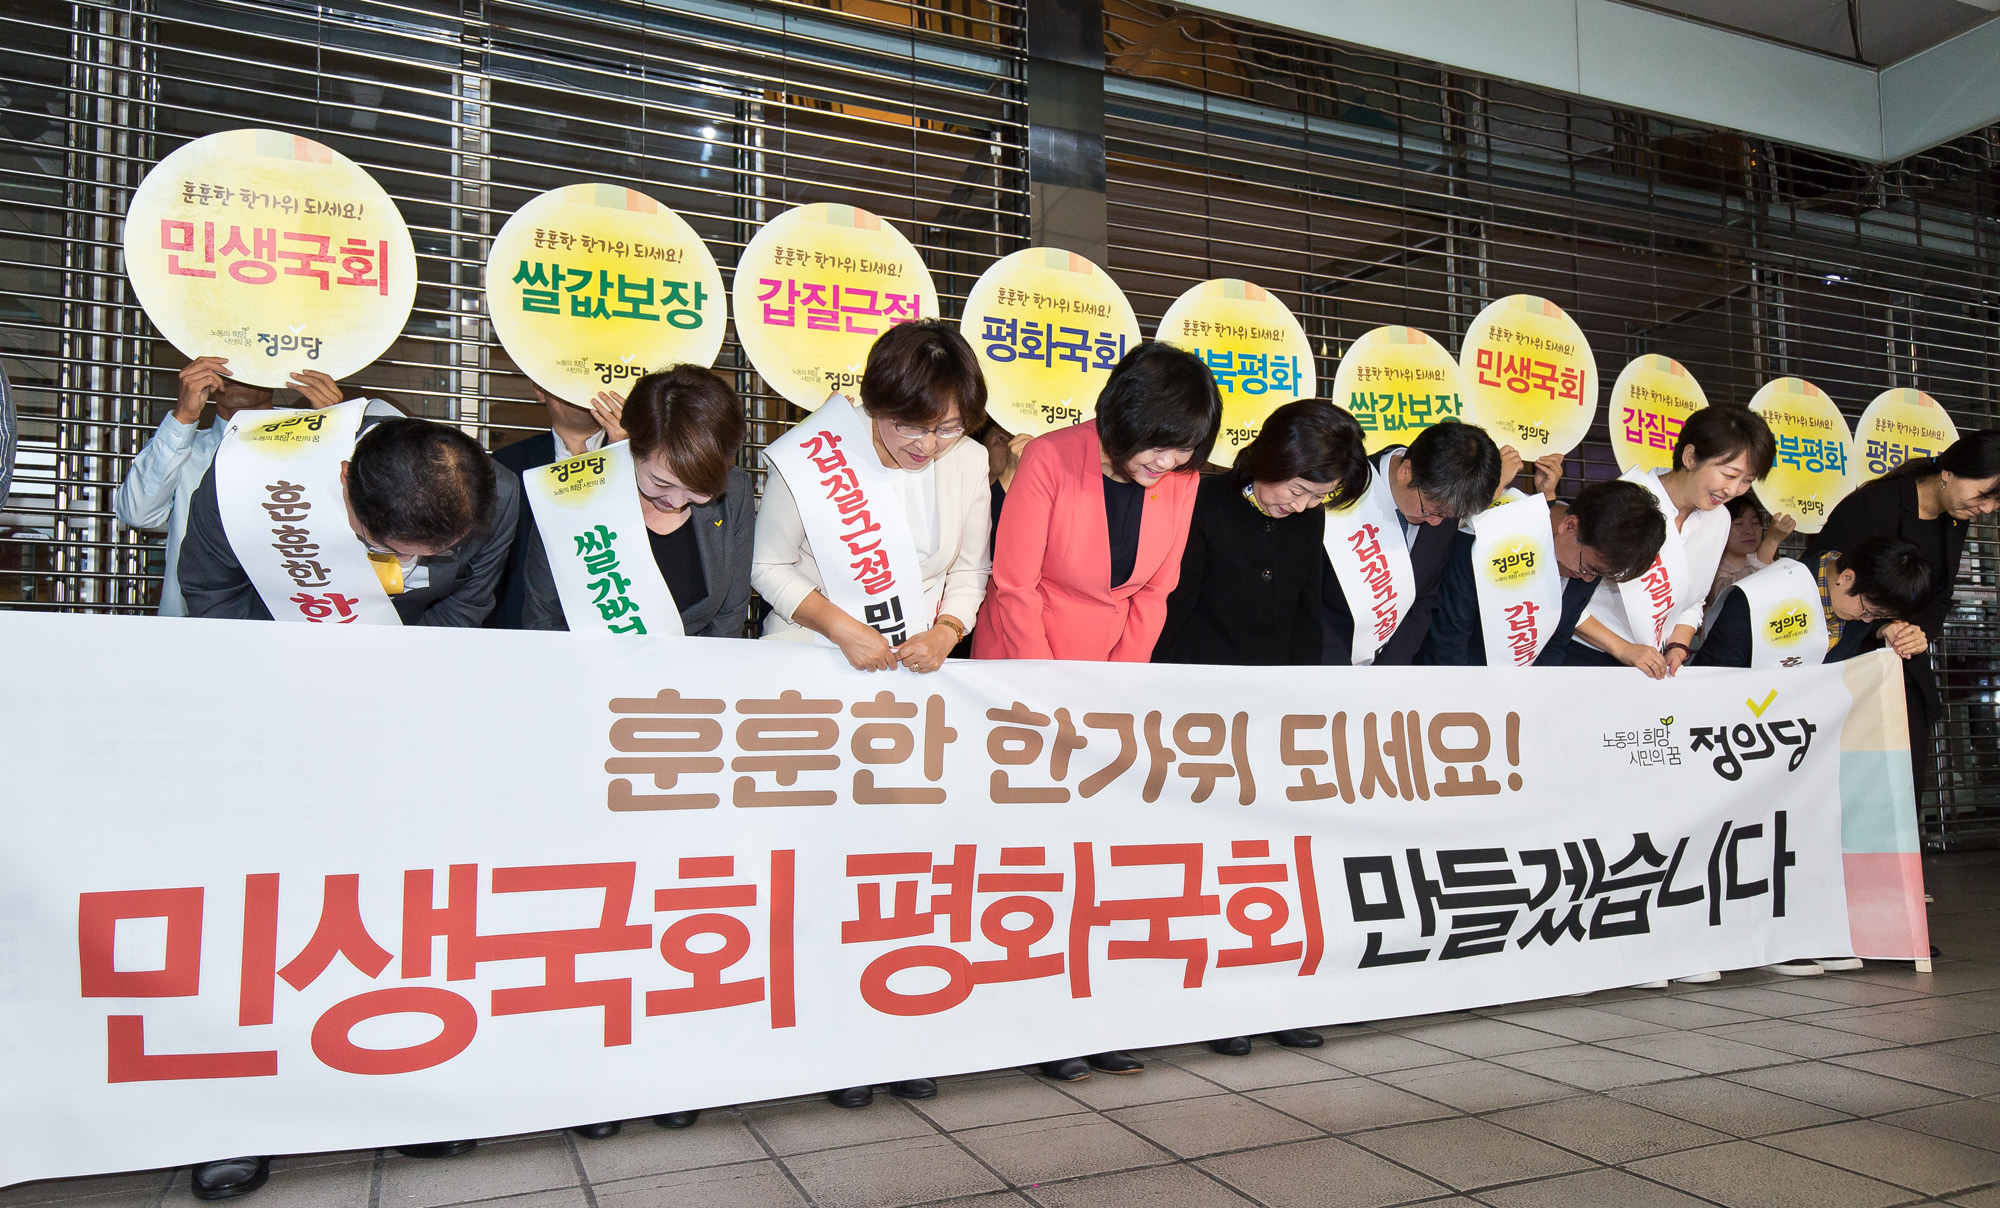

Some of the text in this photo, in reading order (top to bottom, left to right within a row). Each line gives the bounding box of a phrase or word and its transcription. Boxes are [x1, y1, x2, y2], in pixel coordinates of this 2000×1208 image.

[182, 181, 364, 220] 훈훈한 한가위 되세요!
[161, 219, 388, 296] 민생국회
[534, 228, 684, 264] 훈훈한 한가위 되세요!
[774, 246, 903, 278] 훈훈한 한가위 되세요!
[512, 259, 708, 330] 쌀값보장
[757, 278, 920, 335] 갑질근절
[997, 287, 1111, 318] 훈훈한 한가위 되세요!
[257, 333, 323, 360] 정의당
[982, 316, 1126, 373] 평화국회
[1183, 320, 1285, 342] 훈훈한 한가위 되세요!
[1489, 325, 1574, 356] 훈훈한 한가위 되세요!
[1194, 348, 1302, 397] 북평화
[1357, 366, 1445, 382] 훈훈한 한가위 되세요!
[1477, 348, 1585, 406] 민생국회
[1348, 392, 1463, 431] 쌀값보장
[1630, 384, 1697, 412] 훈훈한 한가위 되세요!
[261, 415, 327, 432] 정의당
[1041, 405, 1082, 425] 정의당
[1784, 412, 1807, 427] 한가위
[1810, 417, 1833, 430] 되세요!
[1875, 417, 1945, 441] 훈훈한 한가위 되세요!
[1518, 424, 1549, 444] 정의당
[550, 457, 606, 482] 정의당
[1798, 500, 1824, 516] 정의당
[261, 480, 332, 588] 훈훈한
[800, 430, 907, 647] 갑질근절 민
[1492, 551, 1535, 573] 정의당
[1348, 523, 1398, 642] 갑질근절
[1770, 613, 1807, 633] 정의당
[604, 688, 1523, 813] 훈훈한 한가위 되세요!
[1602, 727, 1670, 749] 노동의 희망
[1689, 717, 1817, 783] 정의당
[1629, 746, 1681, 767] 시민의 꿈
[79, 810, 1796, 1085] 민생국회 평화국회 만들겠습니다
